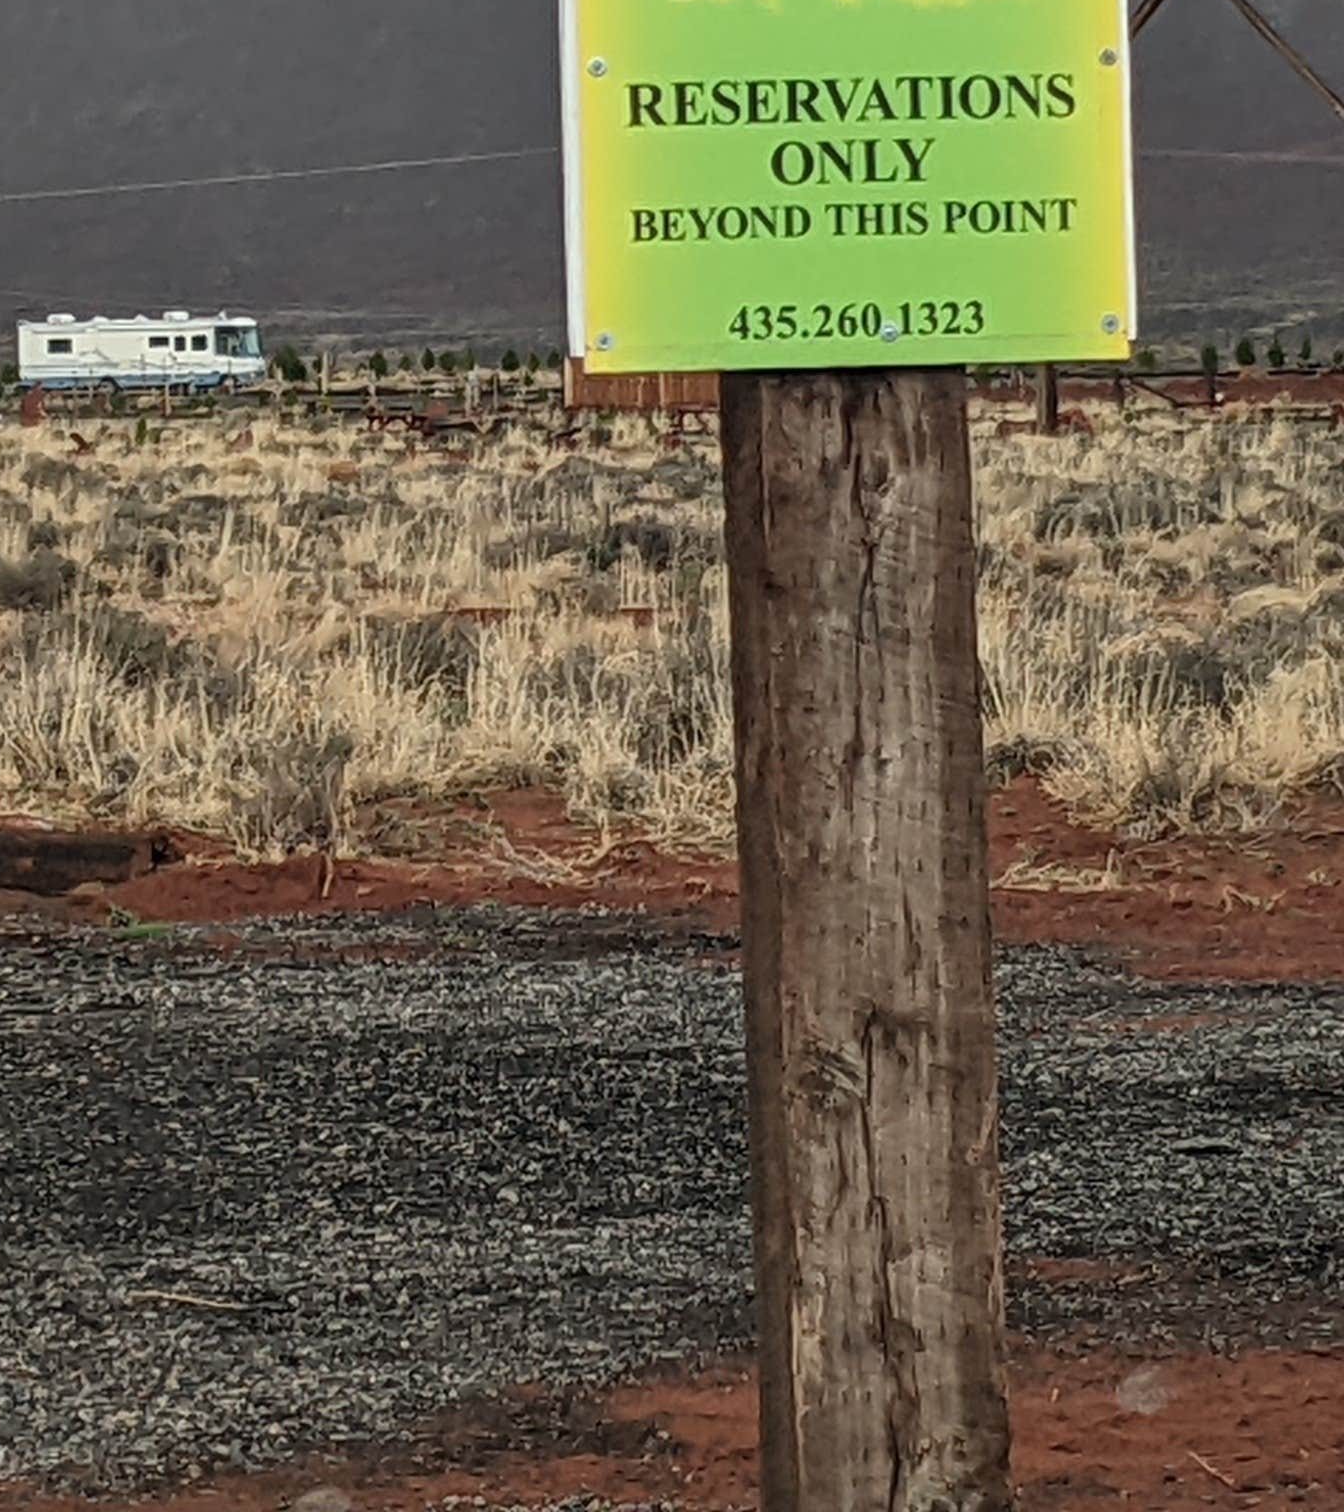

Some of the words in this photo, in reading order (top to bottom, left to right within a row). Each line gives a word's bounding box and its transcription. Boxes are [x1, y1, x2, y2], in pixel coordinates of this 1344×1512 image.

[627, 74, 1076, 127] RESERVATIONS
[770, 138, 935, 185] ONLY
[630, 206, 811, 242] BEYOND
[824, 201, 929, 236] THIS
[944, 198, 1077, 234] POINT
[729, 300, 984, 340] 435.2601323
